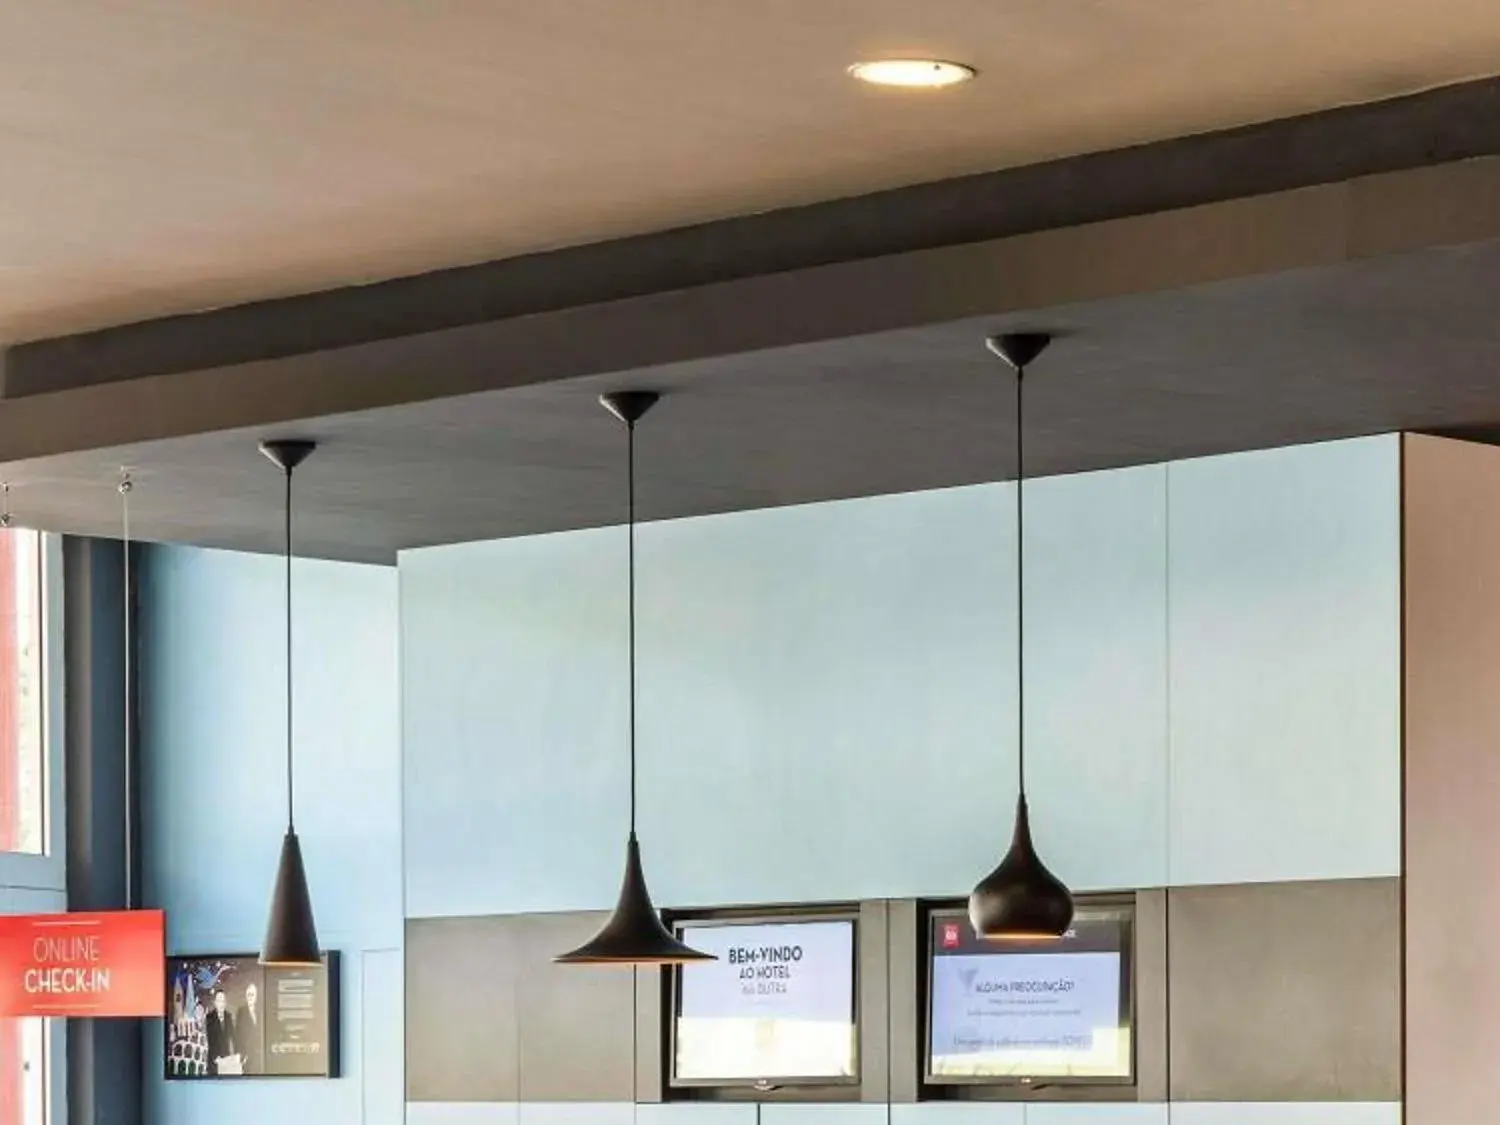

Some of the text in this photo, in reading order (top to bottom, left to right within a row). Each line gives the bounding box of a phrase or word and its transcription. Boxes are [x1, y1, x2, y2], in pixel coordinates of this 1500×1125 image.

[33, 935, 100, 962] ONLINE
[728, 945, 803, 964] BEM-VINDO
[24, 966, 111, 993] CHECK-IN
[757, 965, 791, 979] HOTEL
